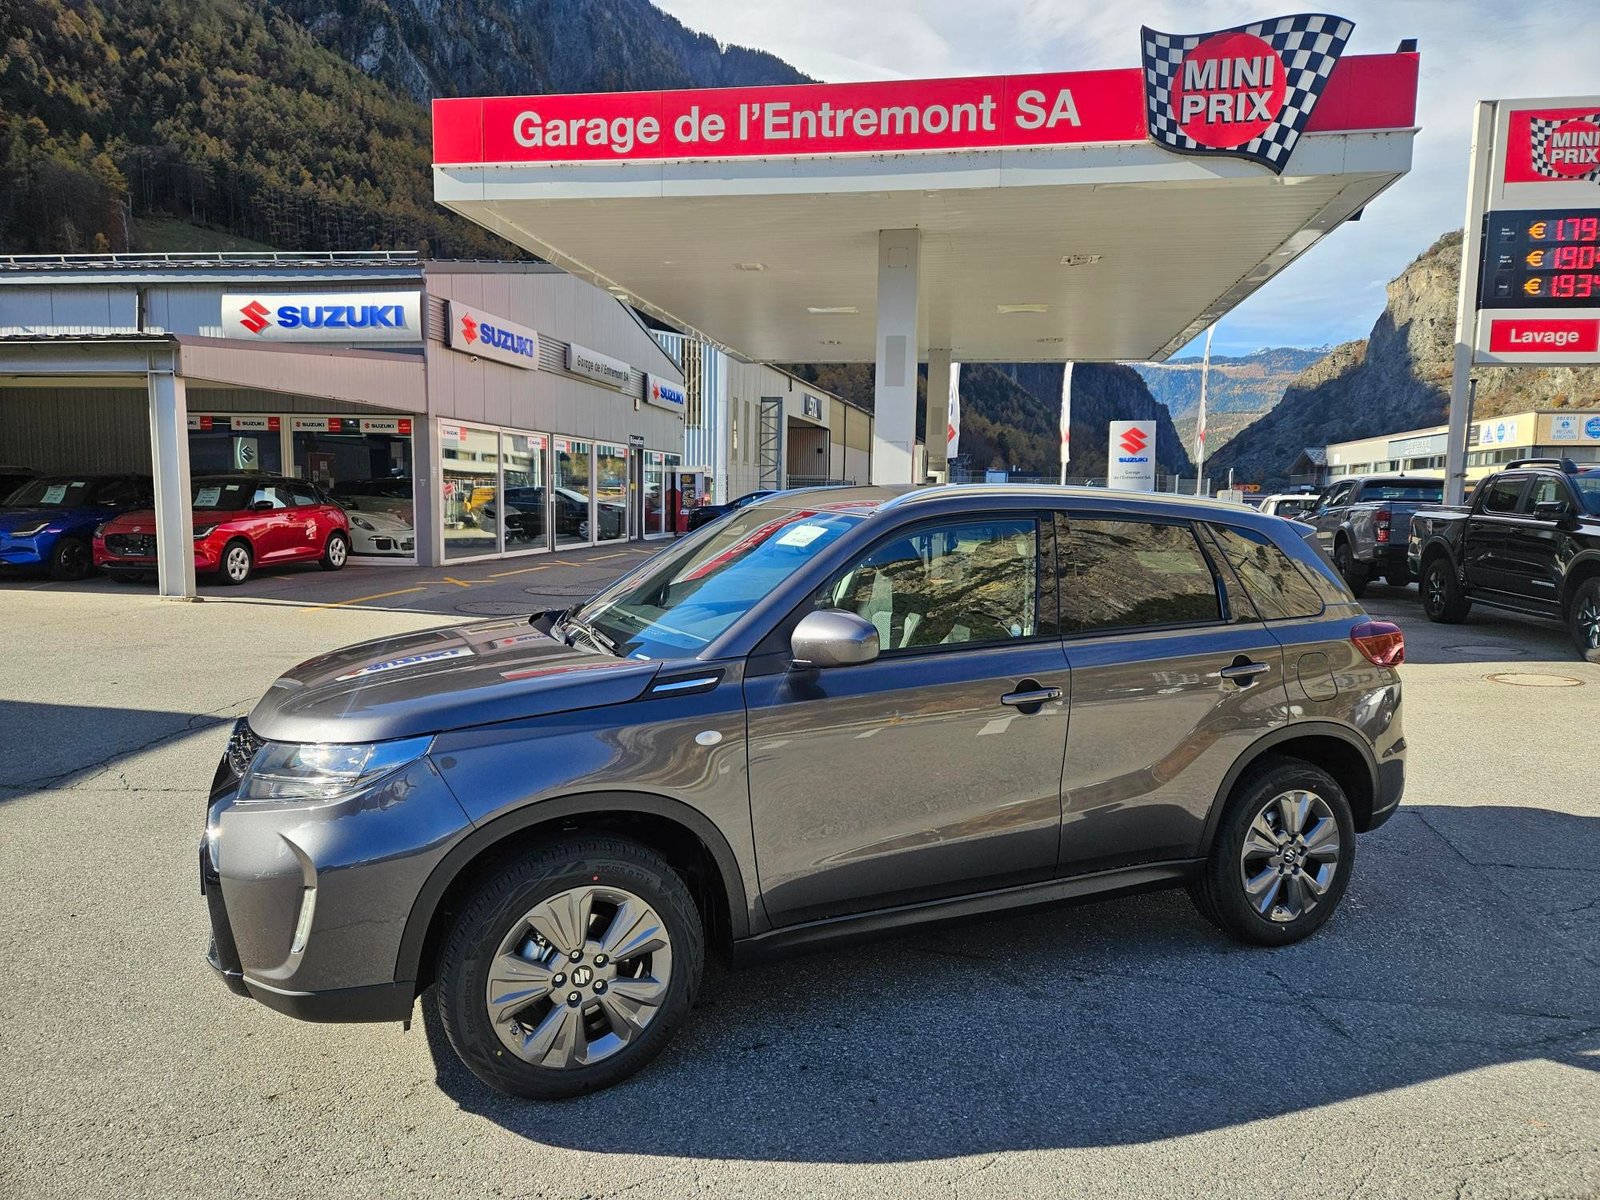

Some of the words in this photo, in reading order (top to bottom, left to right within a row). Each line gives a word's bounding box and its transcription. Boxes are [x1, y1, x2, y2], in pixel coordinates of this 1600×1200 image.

[1183, 55, 1275, 91] MINI
[1181, 91, 1273, 125] PRIX
[513, 110, 660, 153] Garage
[674, 105, 725, 143] de
[739, 94, 996, 141] l'Entremont
[1015, 89, 1082, 130] SA
[1552, 131, 1600, 148] MINI
[1550, 148, 1599, 164] PRIX
[276, 305, 404, 329] SUZUKI
[480, 322, 534, 358] SUZUKI
[1510, 328, 1579, 346] Lavage
[577, 354, 594, 372] Garage
[660, 386, 684, 405] SUZUKI
